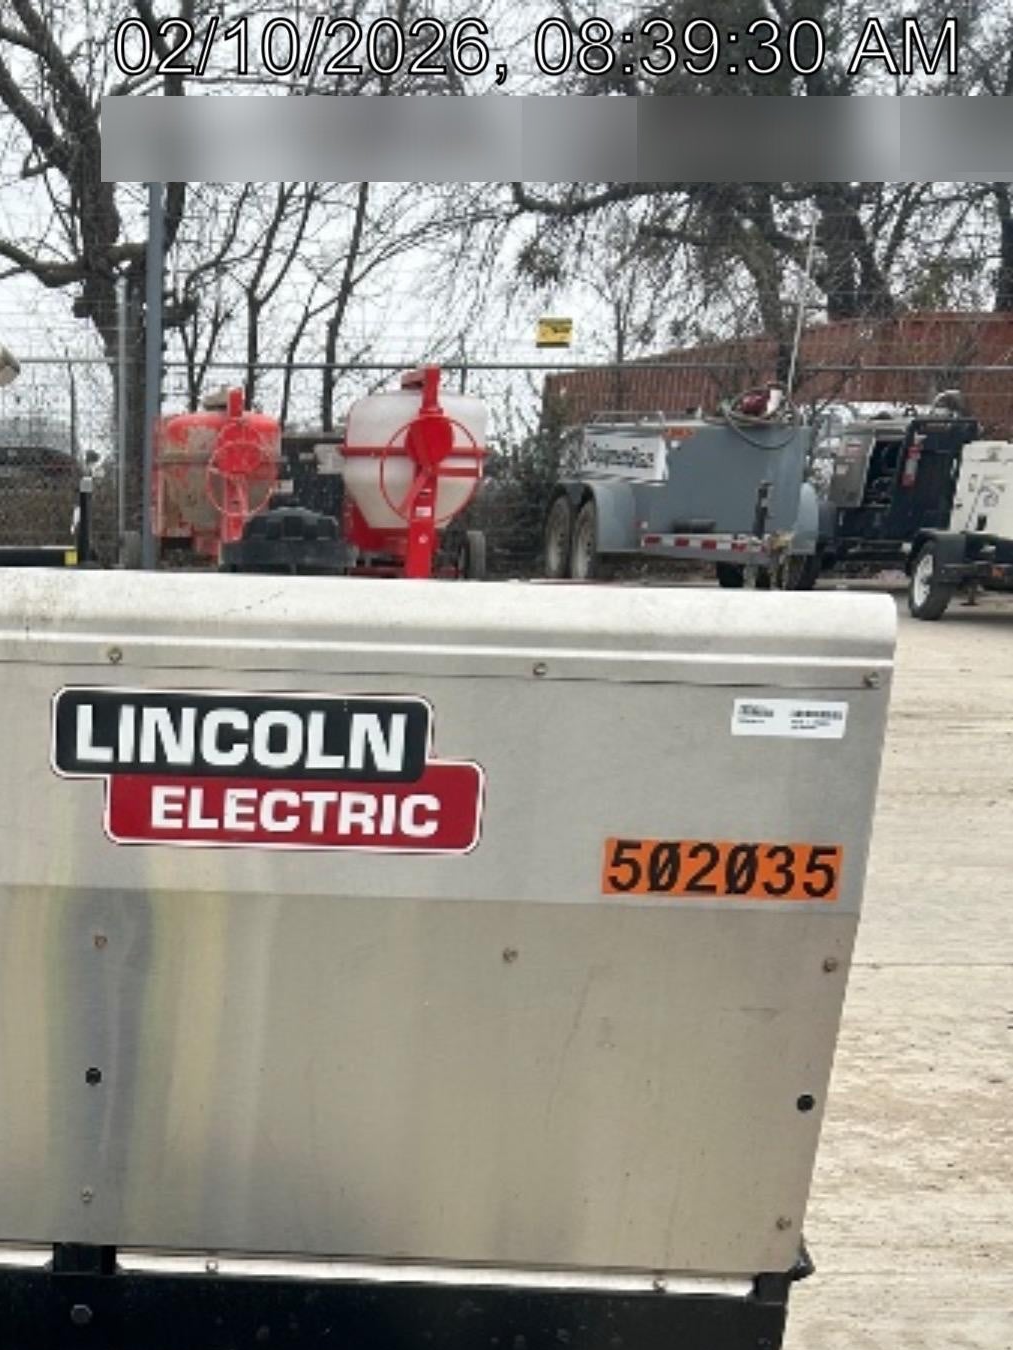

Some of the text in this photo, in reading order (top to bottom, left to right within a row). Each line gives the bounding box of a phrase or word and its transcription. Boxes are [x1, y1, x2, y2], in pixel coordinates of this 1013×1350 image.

[76, 704, 407, 772] LINCOLN
[151, 785, 442, 837] ELECTRIC
[607, 840, 837, 898] 502035
